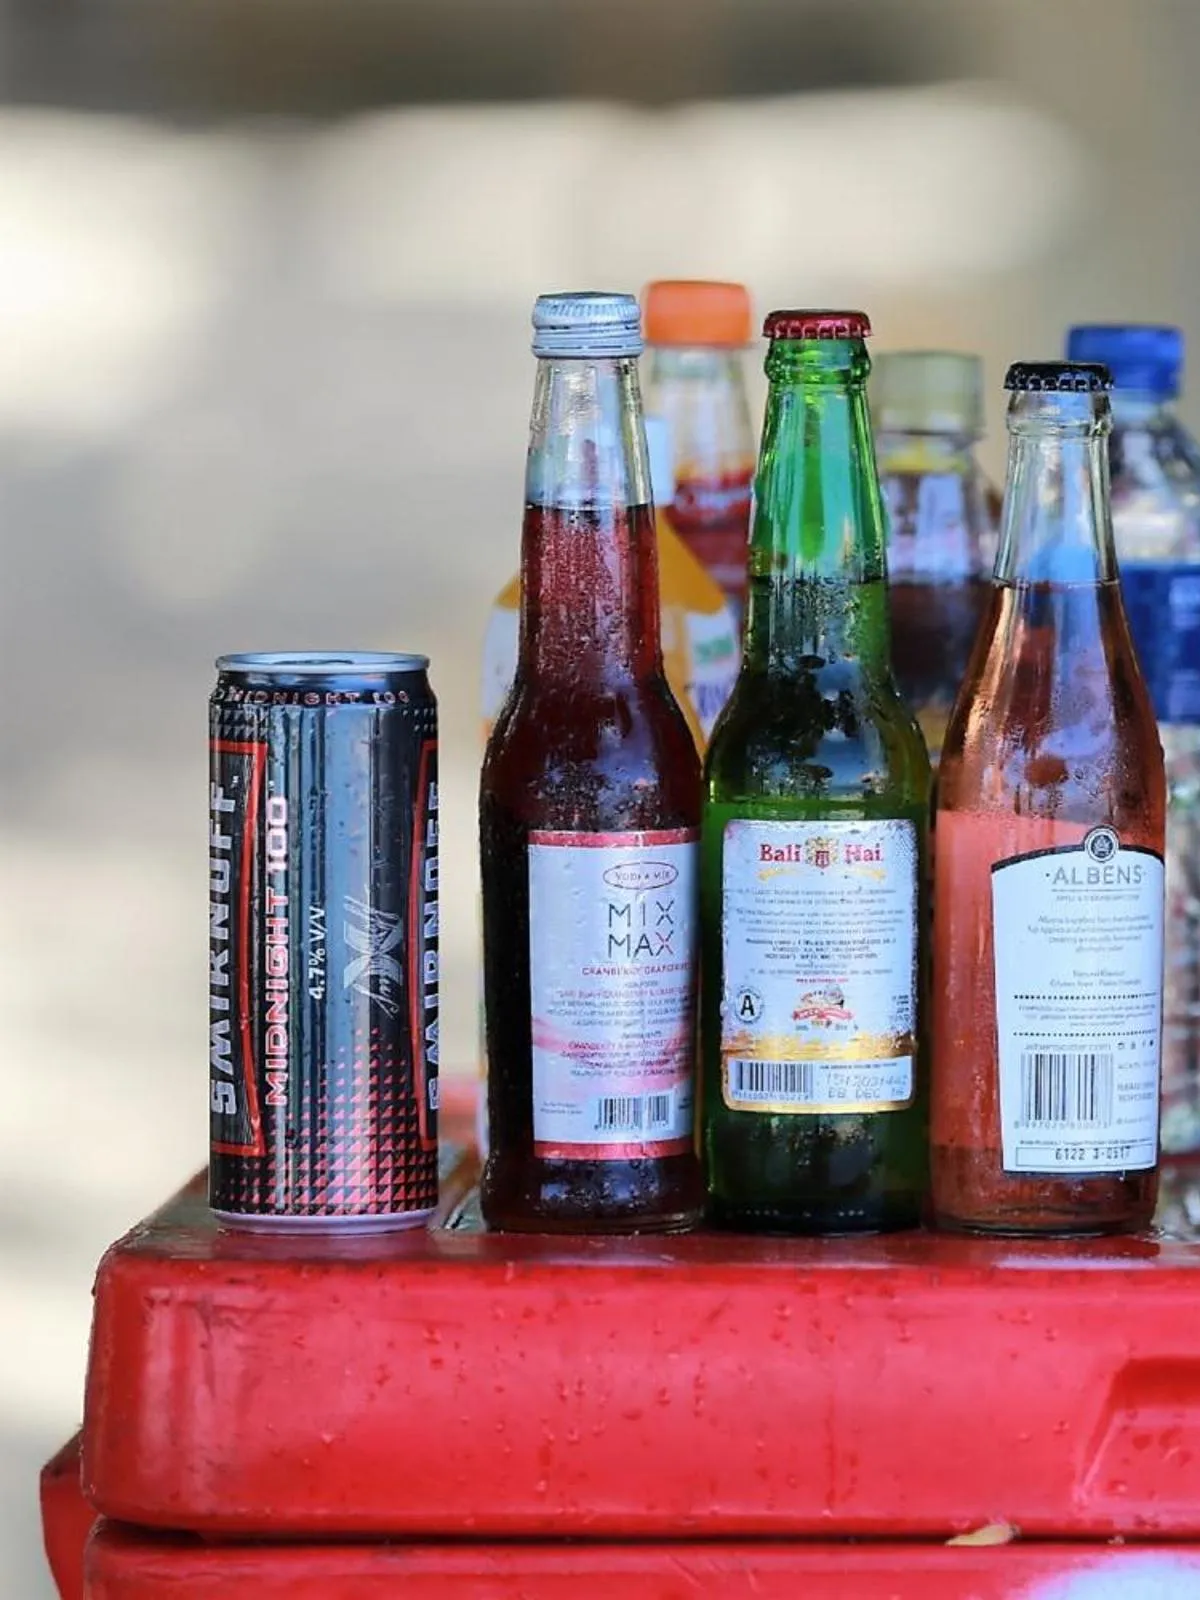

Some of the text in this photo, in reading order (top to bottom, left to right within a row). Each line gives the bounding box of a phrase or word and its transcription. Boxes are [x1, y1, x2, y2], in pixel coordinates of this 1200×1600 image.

[759, 843, 884, 863] Bali Hai
[1052, 864, 1143, 885] ALBENS
[608, 900, 674, 928] MIX
[209, 781, 237, 1115] SMIRNOFF
[264, 793, 289, 1108] MIDNIGHT 100
[308, 904, 326, 1000] 4.7% V/V
[608, 930, 674, 958] MAX
[740, 994, 755, 1017] A
